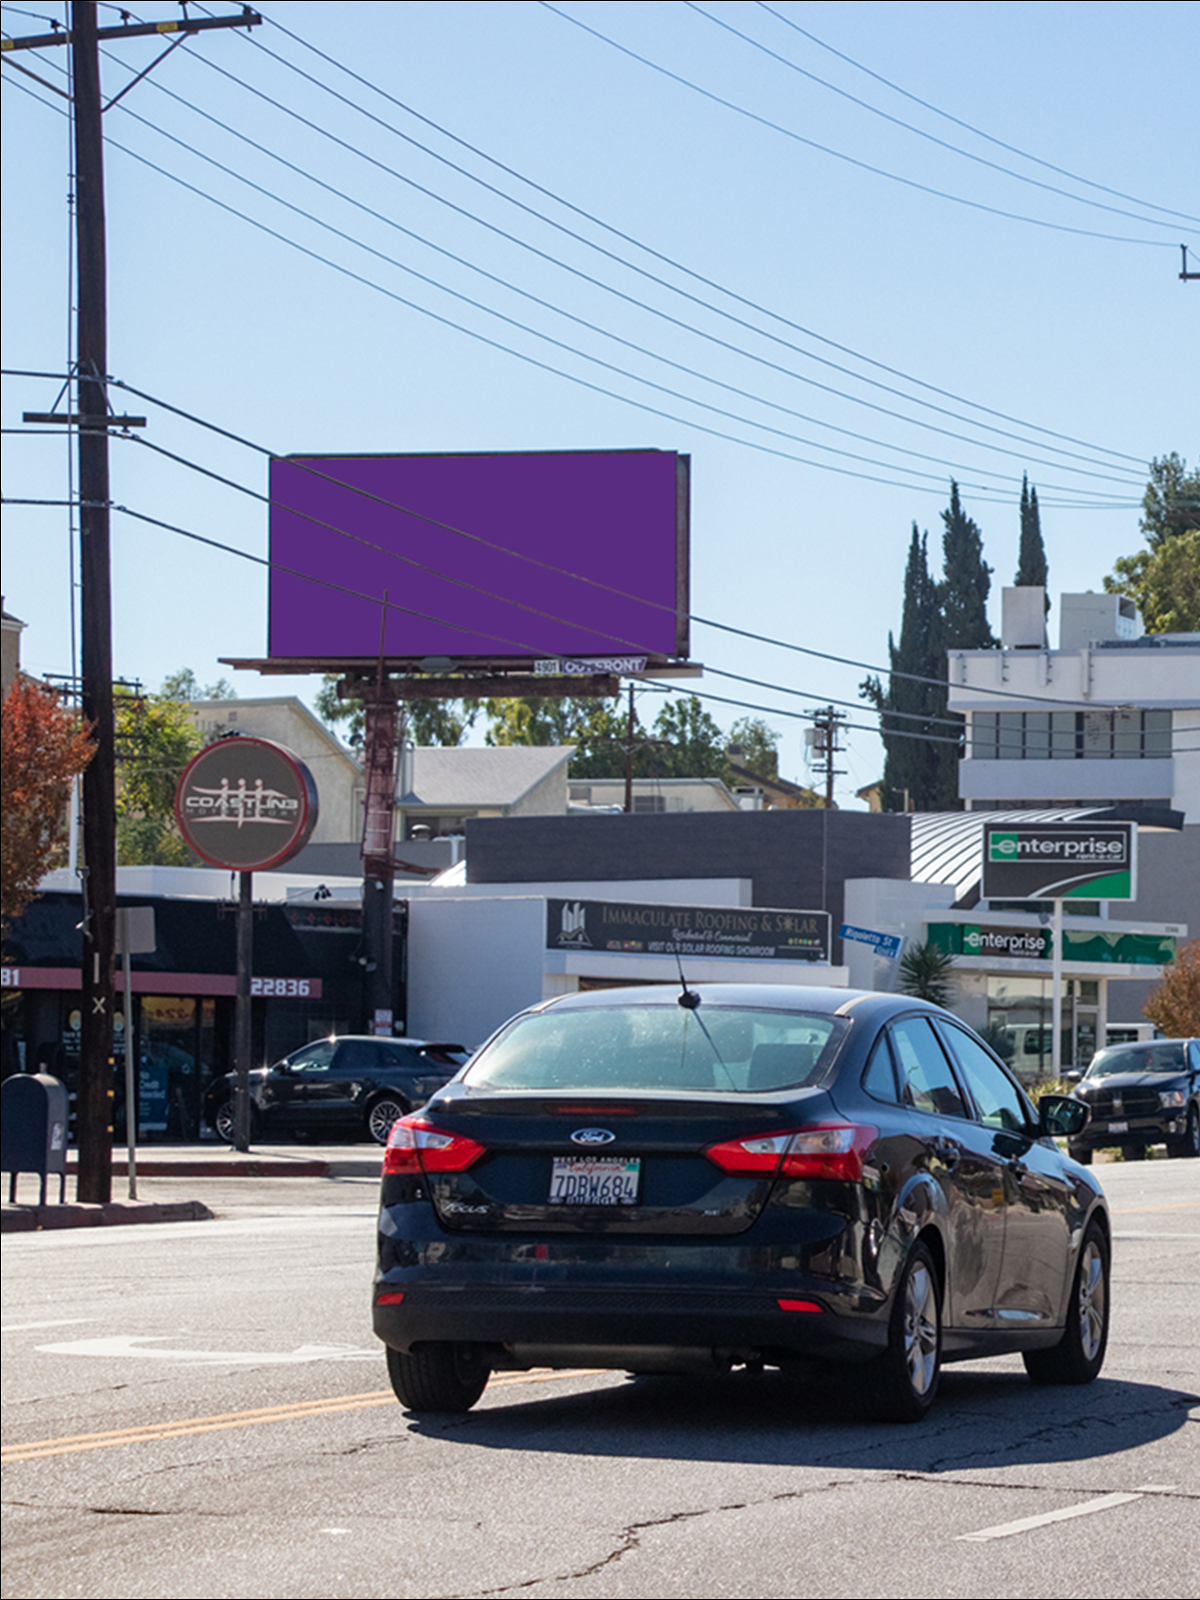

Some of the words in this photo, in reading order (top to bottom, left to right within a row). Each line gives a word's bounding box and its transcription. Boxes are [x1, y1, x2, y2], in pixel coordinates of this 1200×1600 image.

[991, 837, 1123, 857] enterprise
[1075, 852, 1123, 860] rent-a-car
[602, 905, 691, 928] IMMACULATE
[695, 910, 758, 932] ROOFING
[761, 914, 773, 932] &
[682, 942, 705, 954] SOLAR
[882, 936, 894, 947] St
[963, 932, 1046, 952] enterprise
[250, 978, 310, 996] 22836
[555, 1174, 634, 1198] 7DBW684
